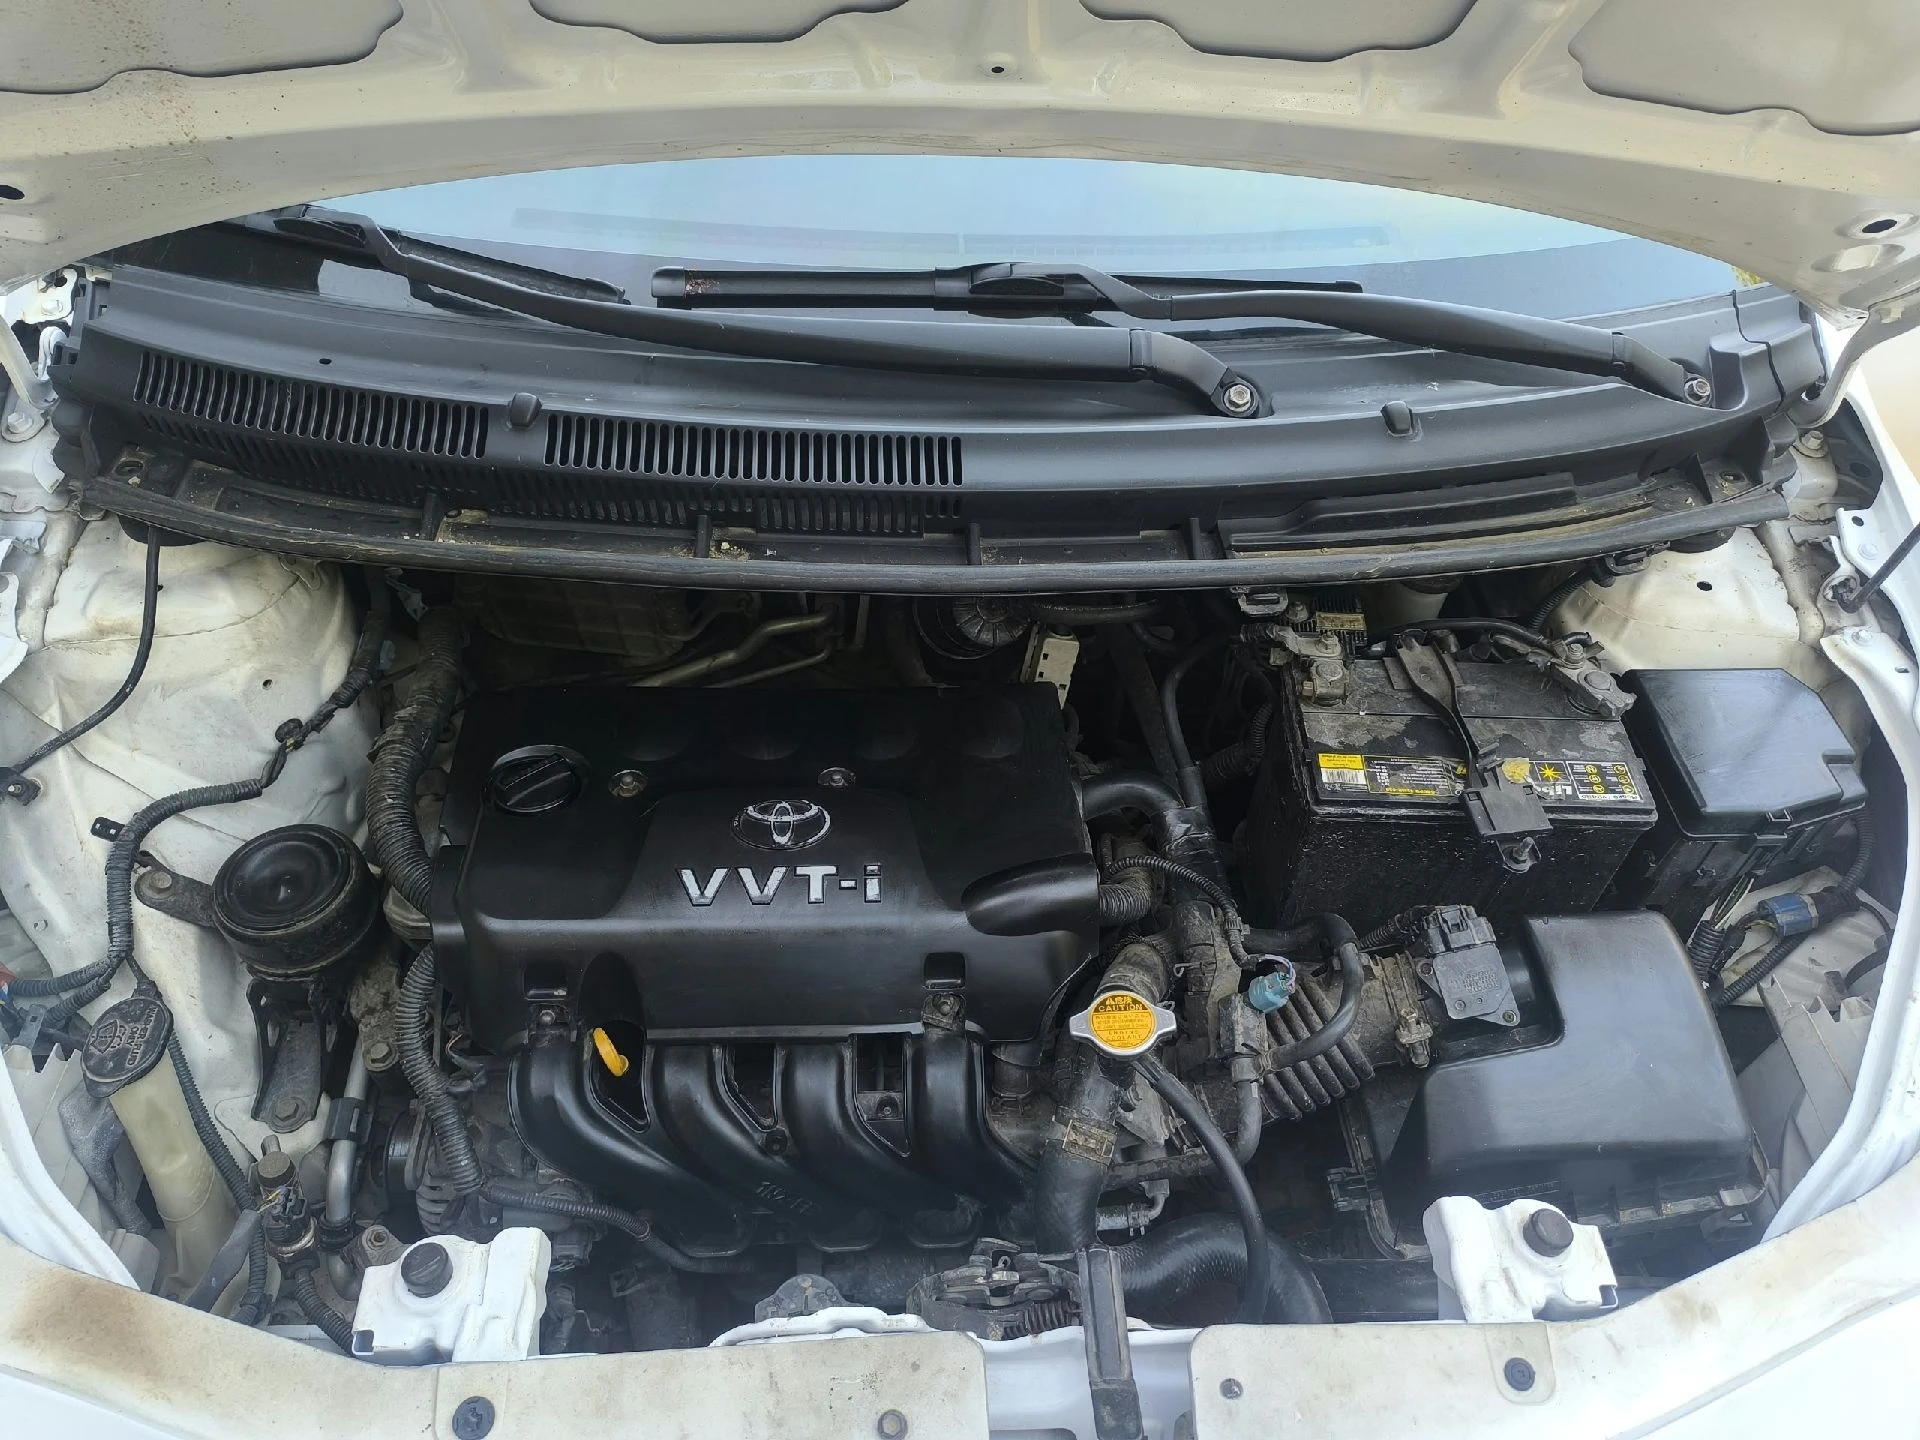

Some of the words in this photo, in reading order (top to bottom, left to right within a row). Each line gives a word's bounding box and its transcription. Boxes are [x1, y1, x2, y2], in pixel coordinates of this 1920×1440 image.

[675, 863, 882, 907] VVT-i
[1098, 1004, 1143, 1012] CAUTION
[137, 1007, 158, 1040] WASHER
[125, 1025, 140, 1047] ONLY
[126, 1043, 143, 1067] FLUID
